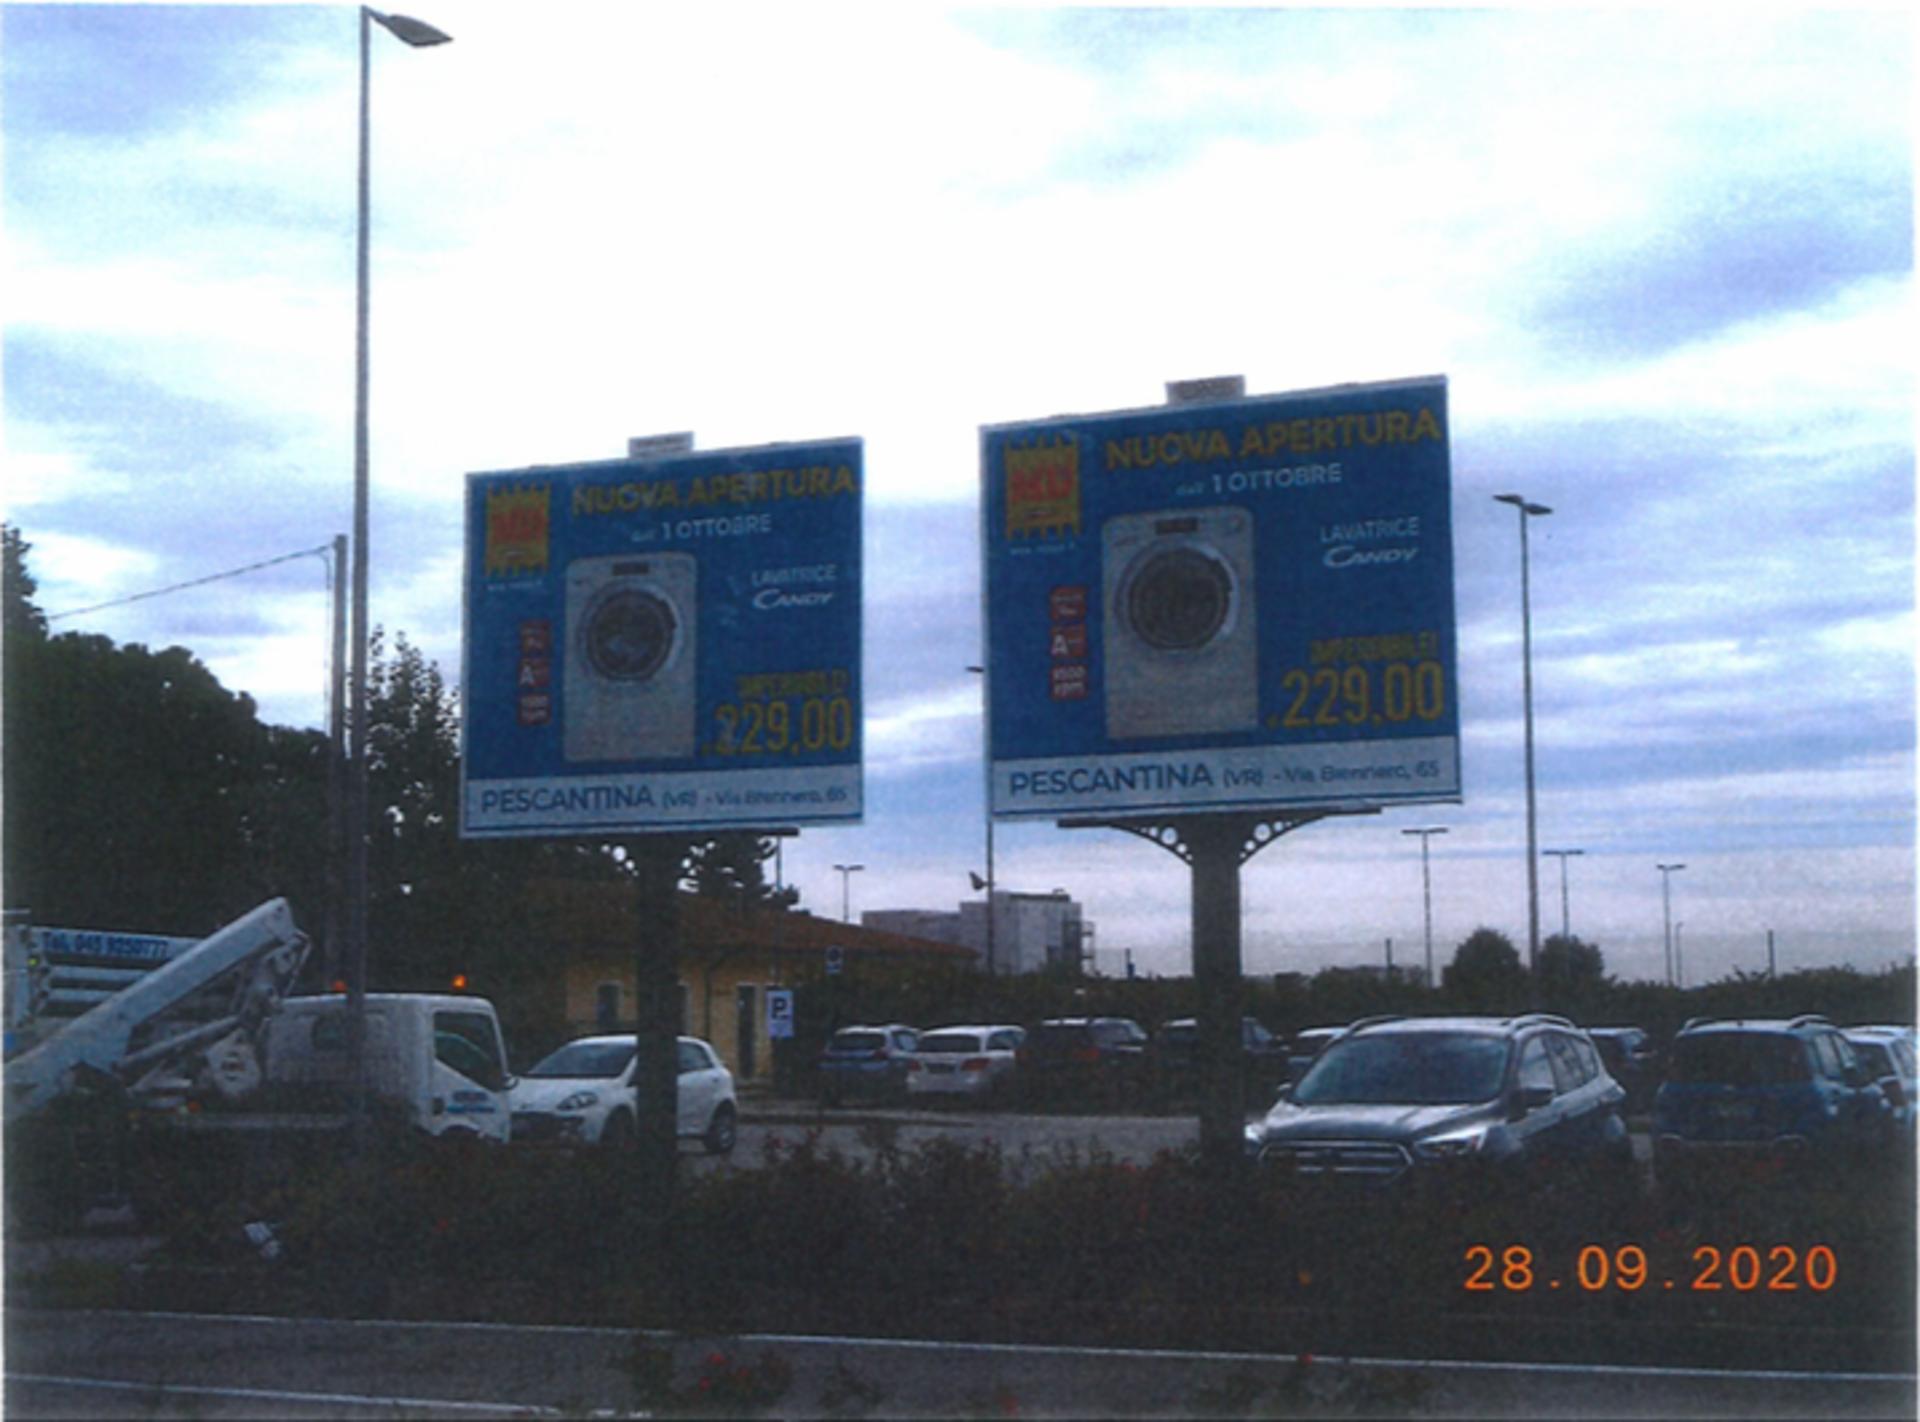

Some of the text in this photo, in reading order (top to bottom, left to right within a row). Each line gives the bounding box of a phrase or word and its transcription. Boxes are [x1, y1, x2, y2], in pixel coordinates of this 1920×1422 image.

[1105, 408, 1441, 470] NUOVA APERTURA
[572, 465, 856, 516] NUOVA APERTURA
[1212, 474, 1222, 494] 1
[1227, 462, 1342, 492] OTTOBRE
[662, 521, 671, 540] 1
[676, 514, 772, 538] OTTOBRE
[1321, 516, 1420, 543] LAVATRICE
[752, 564, 837, 586] LAVATRICE
[1010, 763, 1214, 796] PESCANTINA
[482, 785, 655, 814] PESCANTINA
[771, 997, 788, 1019] P
